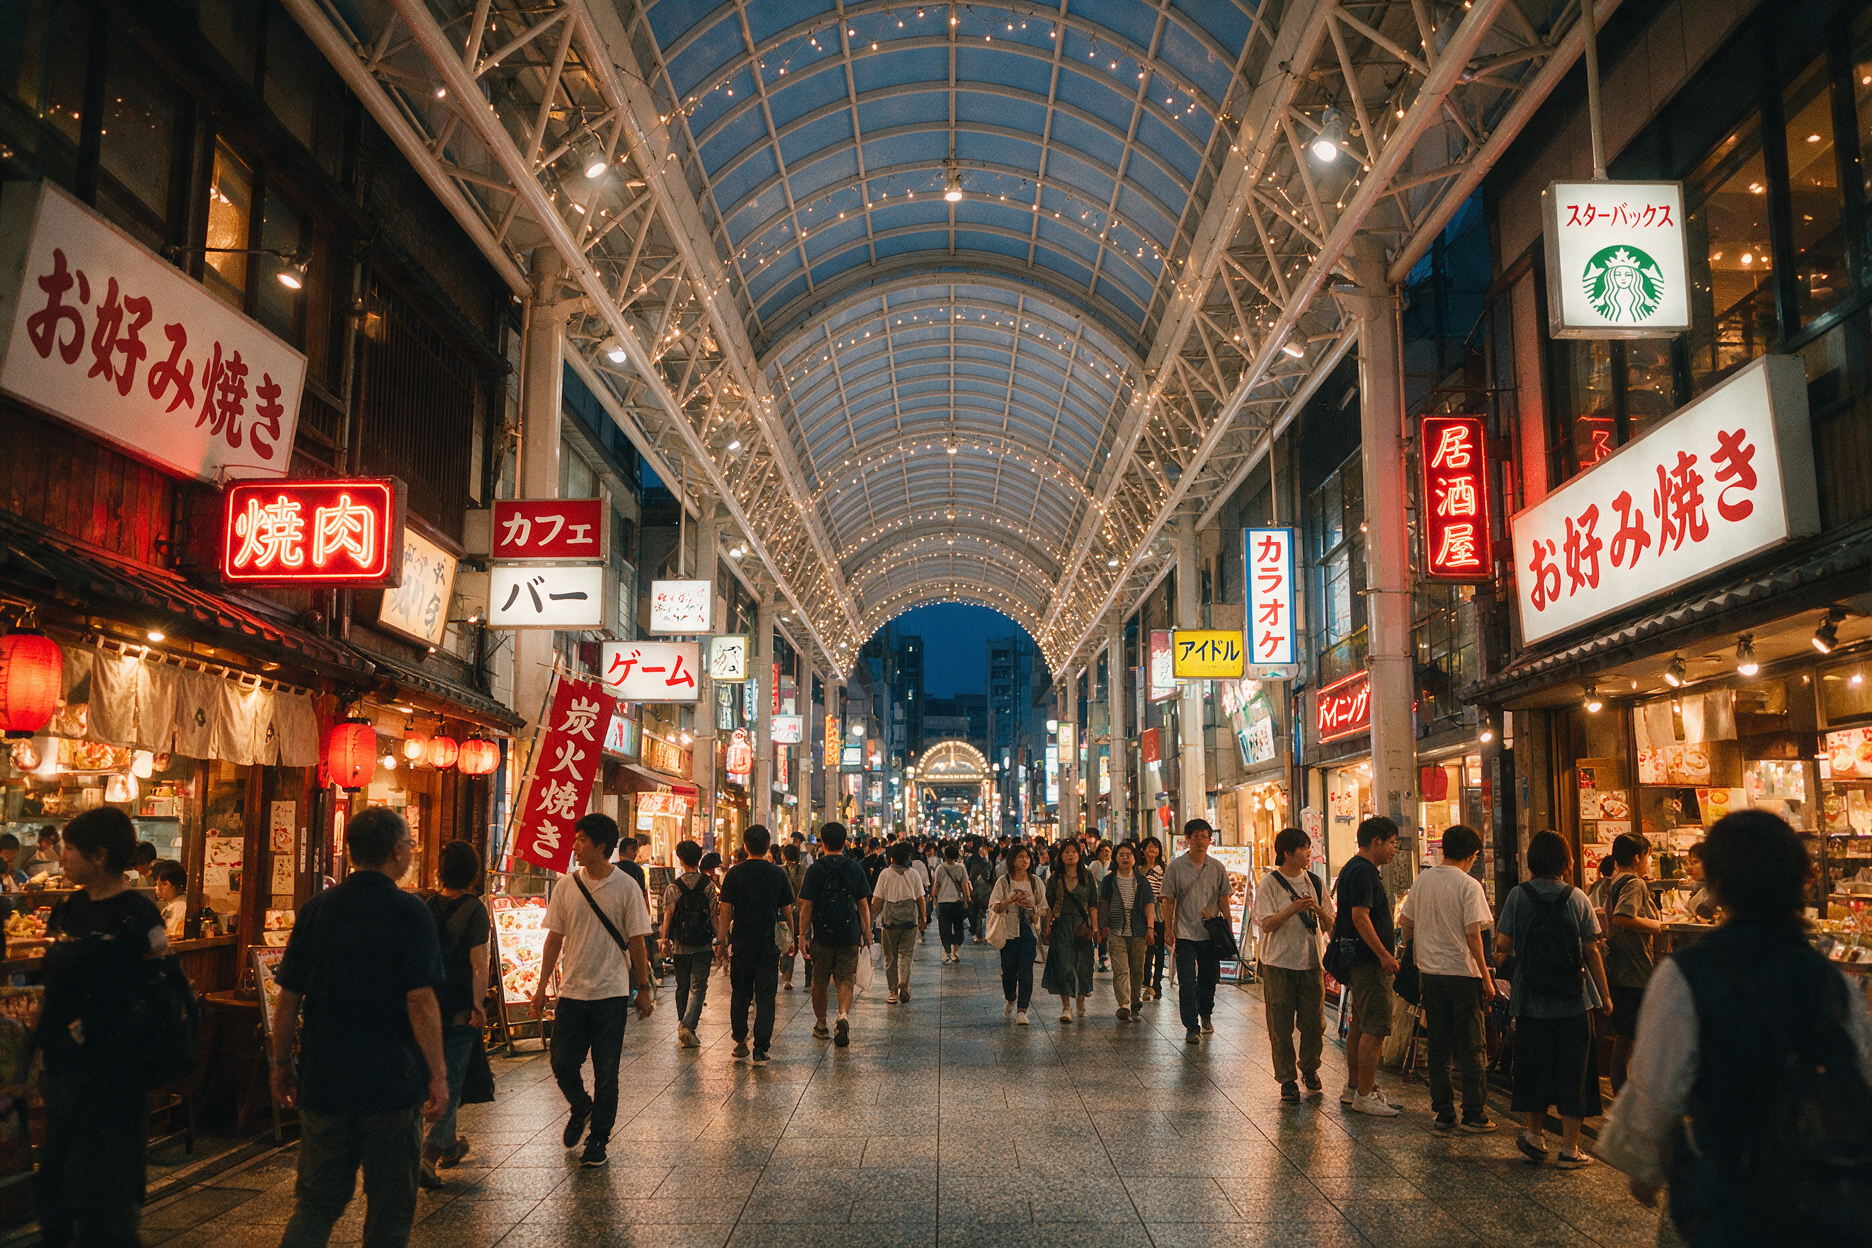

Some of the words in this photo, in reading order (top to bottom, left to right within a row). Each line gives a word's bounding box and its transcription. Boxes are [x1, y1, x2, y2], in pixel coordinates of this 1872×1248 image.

[1566, 202, 1673, 228] スターバックス
[26, 248, 284, 460] お好み焼き
[233, 495, 375, 568] 焼肉
[501, 511, 593, 546] カフェ
[1431, 425, 1479, 567] 居酒屋
[1529, 427, 1757, 613] お好み焼き
[501, 576, 588, 613] バー
[1257, 535, 1285, 659] カラオケ
[607, 649, 695, 688] ゲーム
[1178, 639, 1240, 662] アイドル
[532, 696, 600, 859] 炭火焼き
